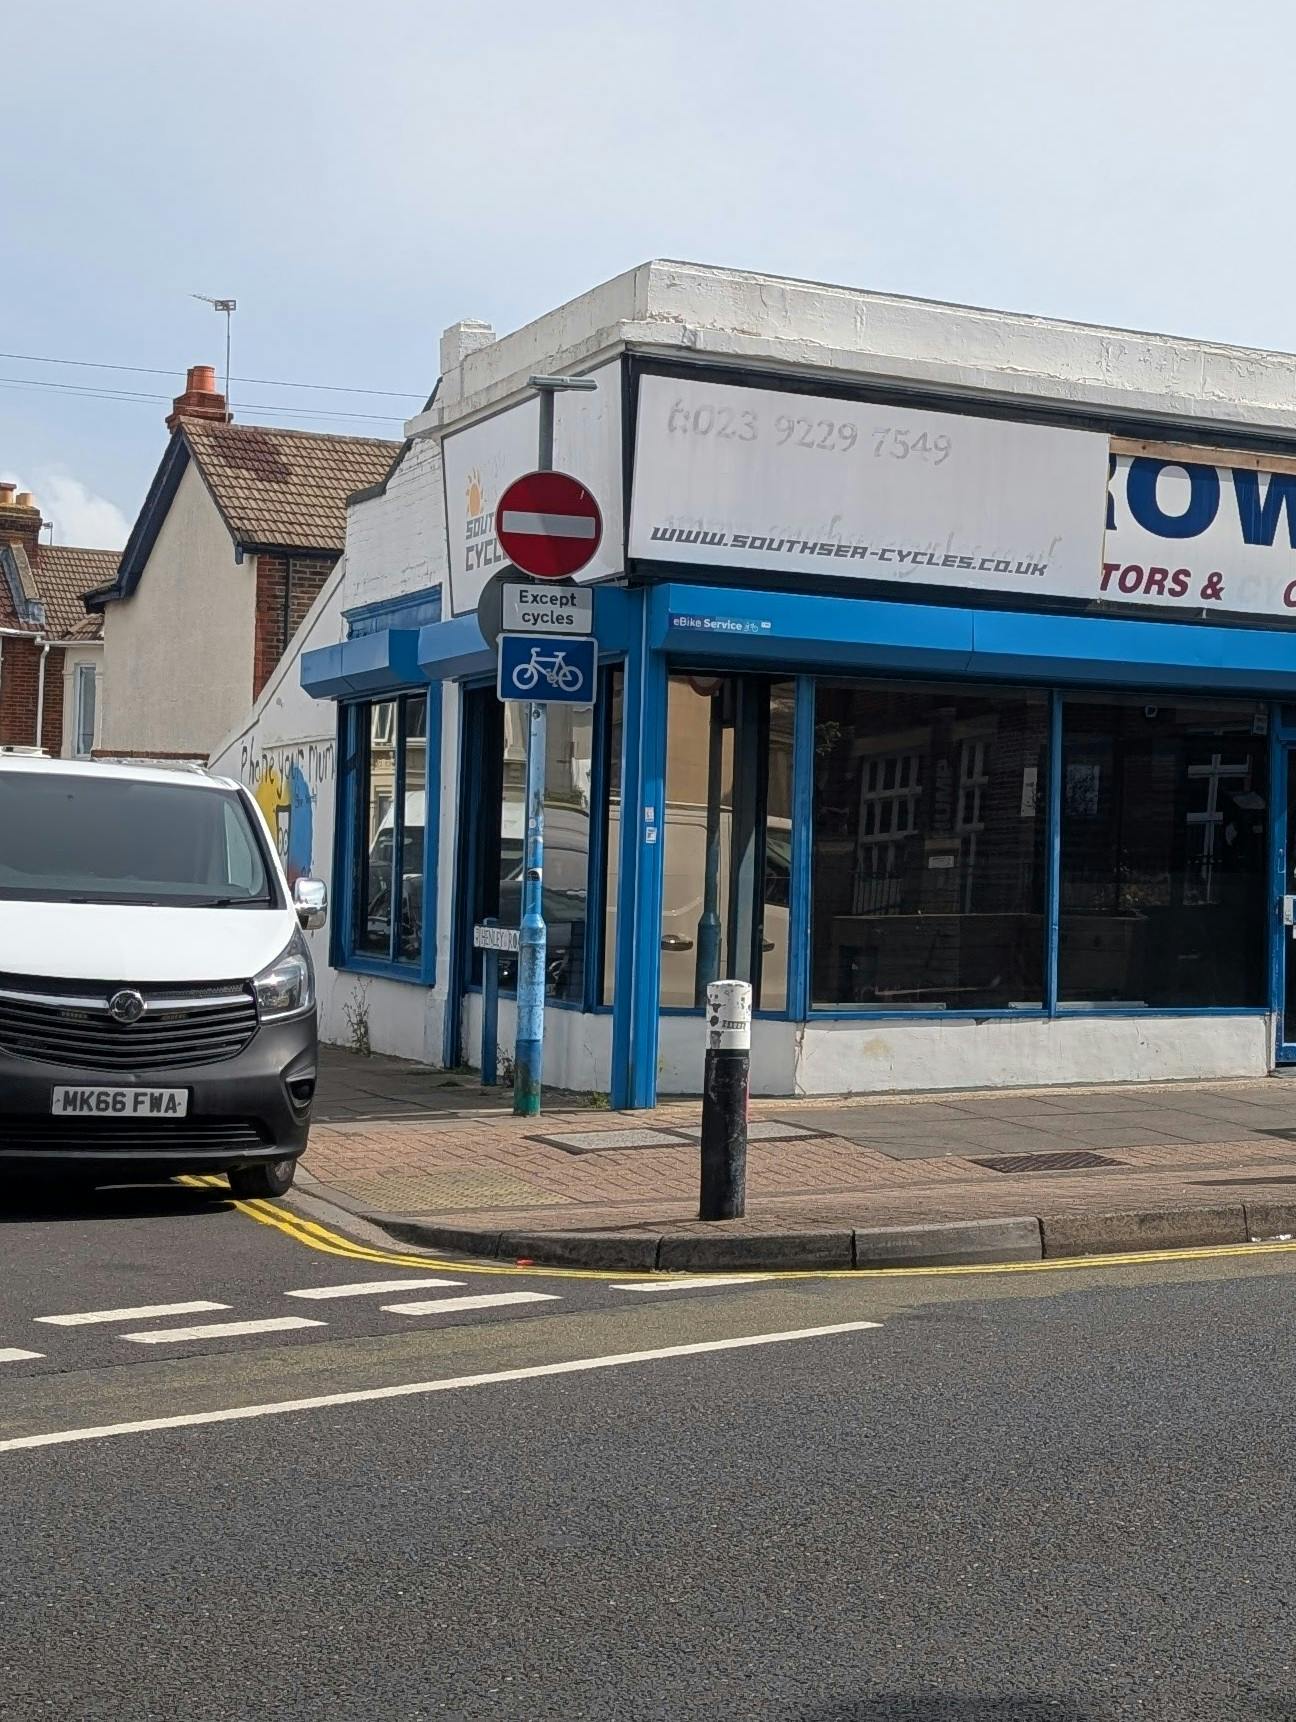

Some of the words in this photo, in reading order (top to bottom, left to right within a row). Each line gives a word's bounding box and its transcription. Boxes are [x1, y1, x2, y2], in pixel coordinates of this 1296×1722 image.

[774, 415, 858, 453] 9229
[871, 427, 953, 466] 7549
[465, 511, 497, 541] SOUT
[465, 537, 508, 572] CYCL
[1100, 562, 1192, 598] TORS
[1200, 571, 1226, 601] &
[518, 589, 577, 609] Except
[521, 610, 574, 627] cycles
[673, 616, 702, 628] eBike
[703, 618, 743, 631] Service
[62, 1089, 127, 1113] MK66
[132, 1091, 178, 1114] FWA
